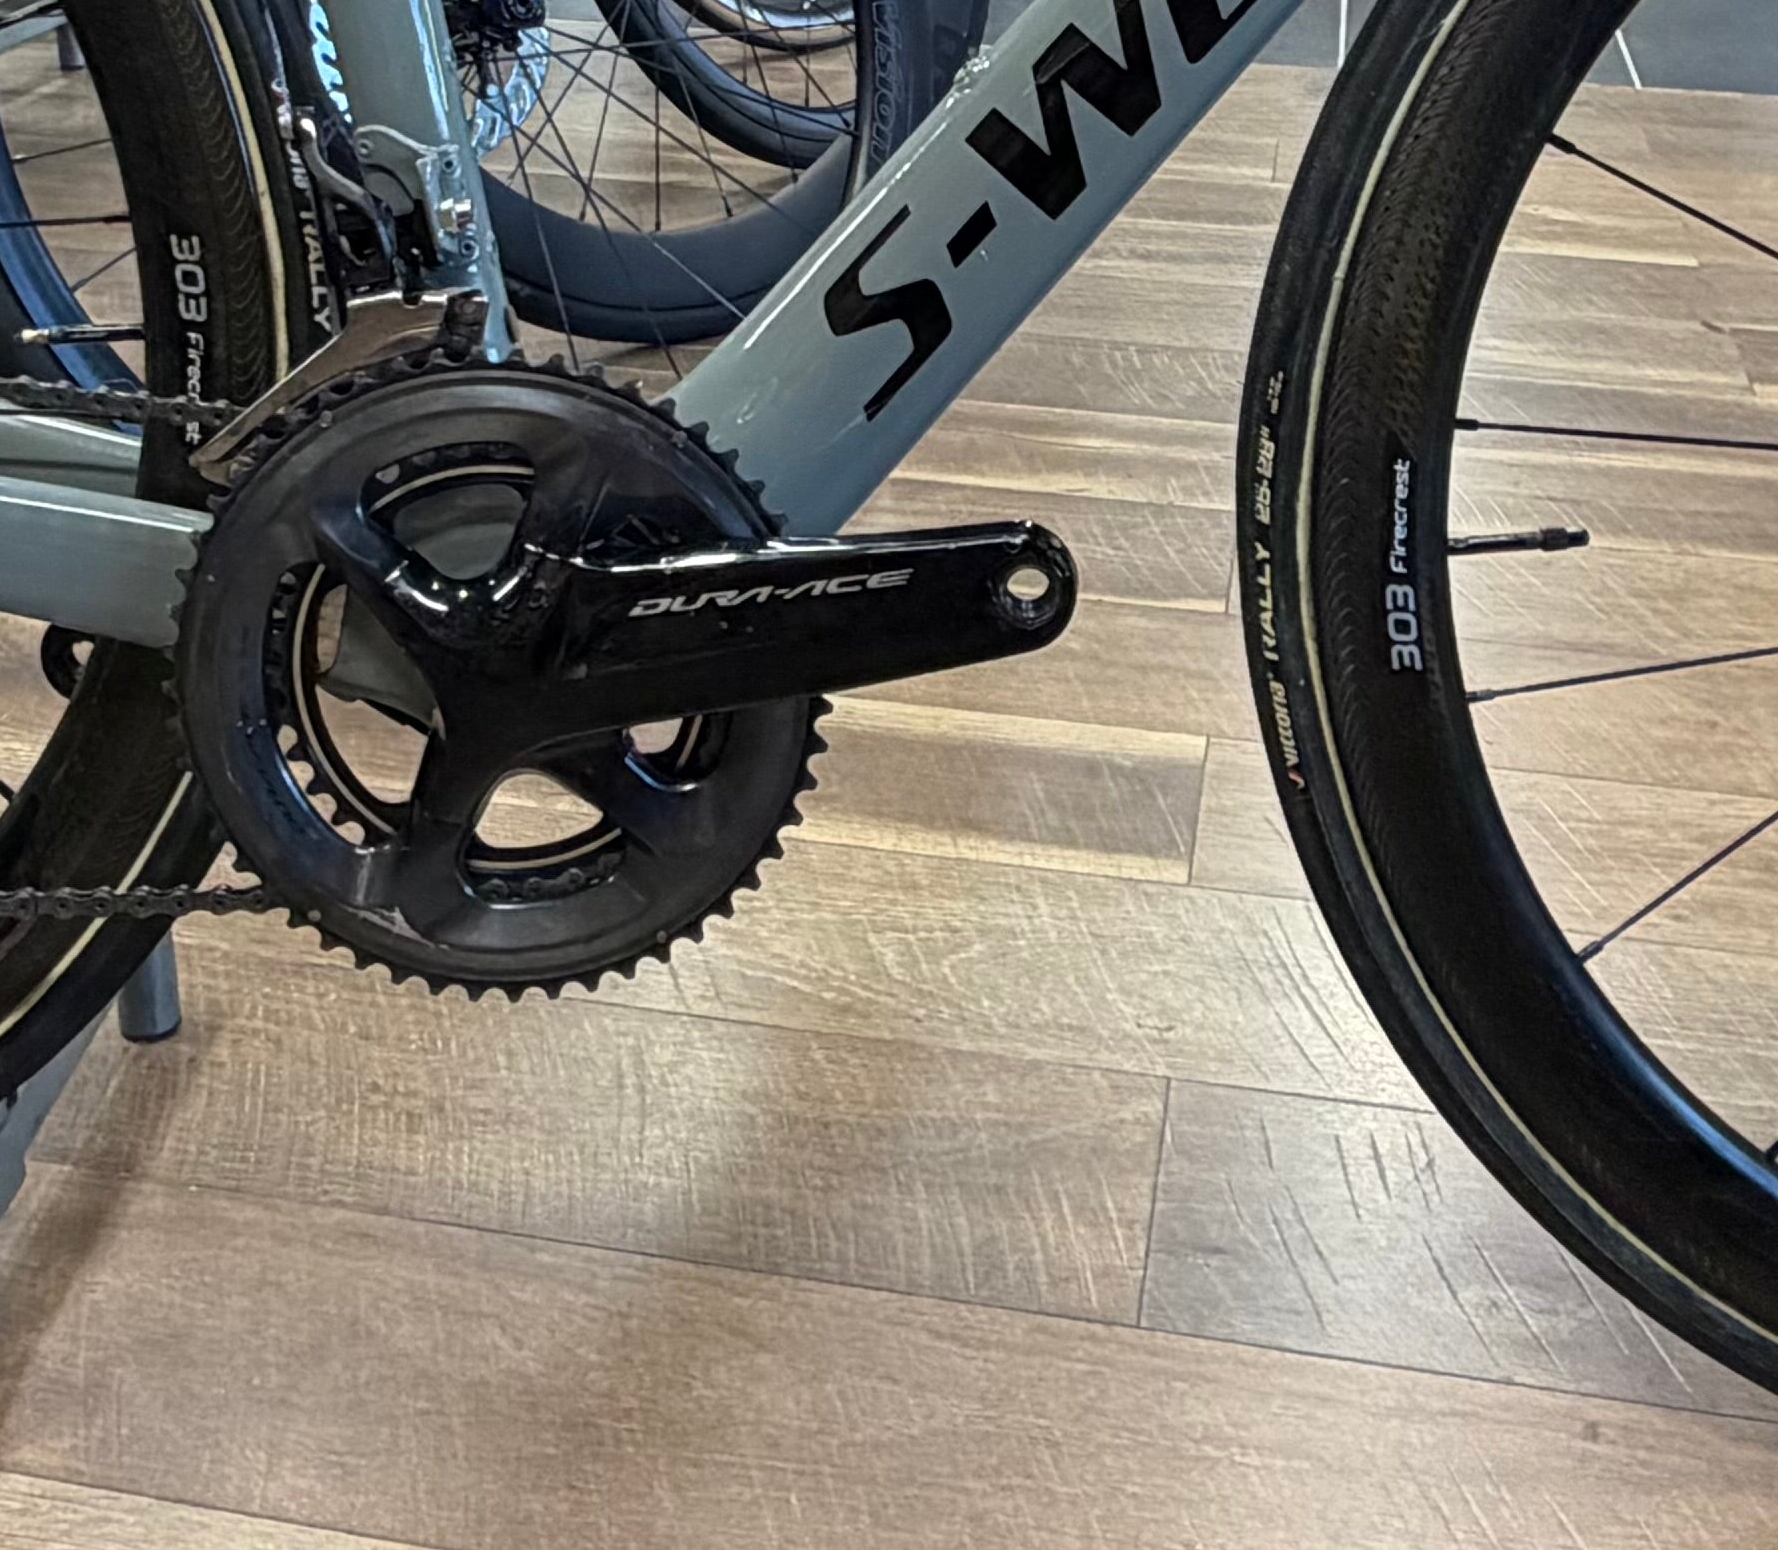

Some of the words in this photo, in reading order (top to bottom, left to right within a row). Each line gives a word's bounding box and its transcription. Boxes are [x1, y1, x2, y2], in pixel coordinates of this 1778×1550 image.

[169, 233, 208, 323] 303
[299, 210, 333, 333] RALLY
[1389, 458, 1411, 574] Firecrest
[628, 568, 915, 618] DURA-ACE
[1259, 542, 1281, 663] RALLY
[1385, 582, 1423, 671] 303
